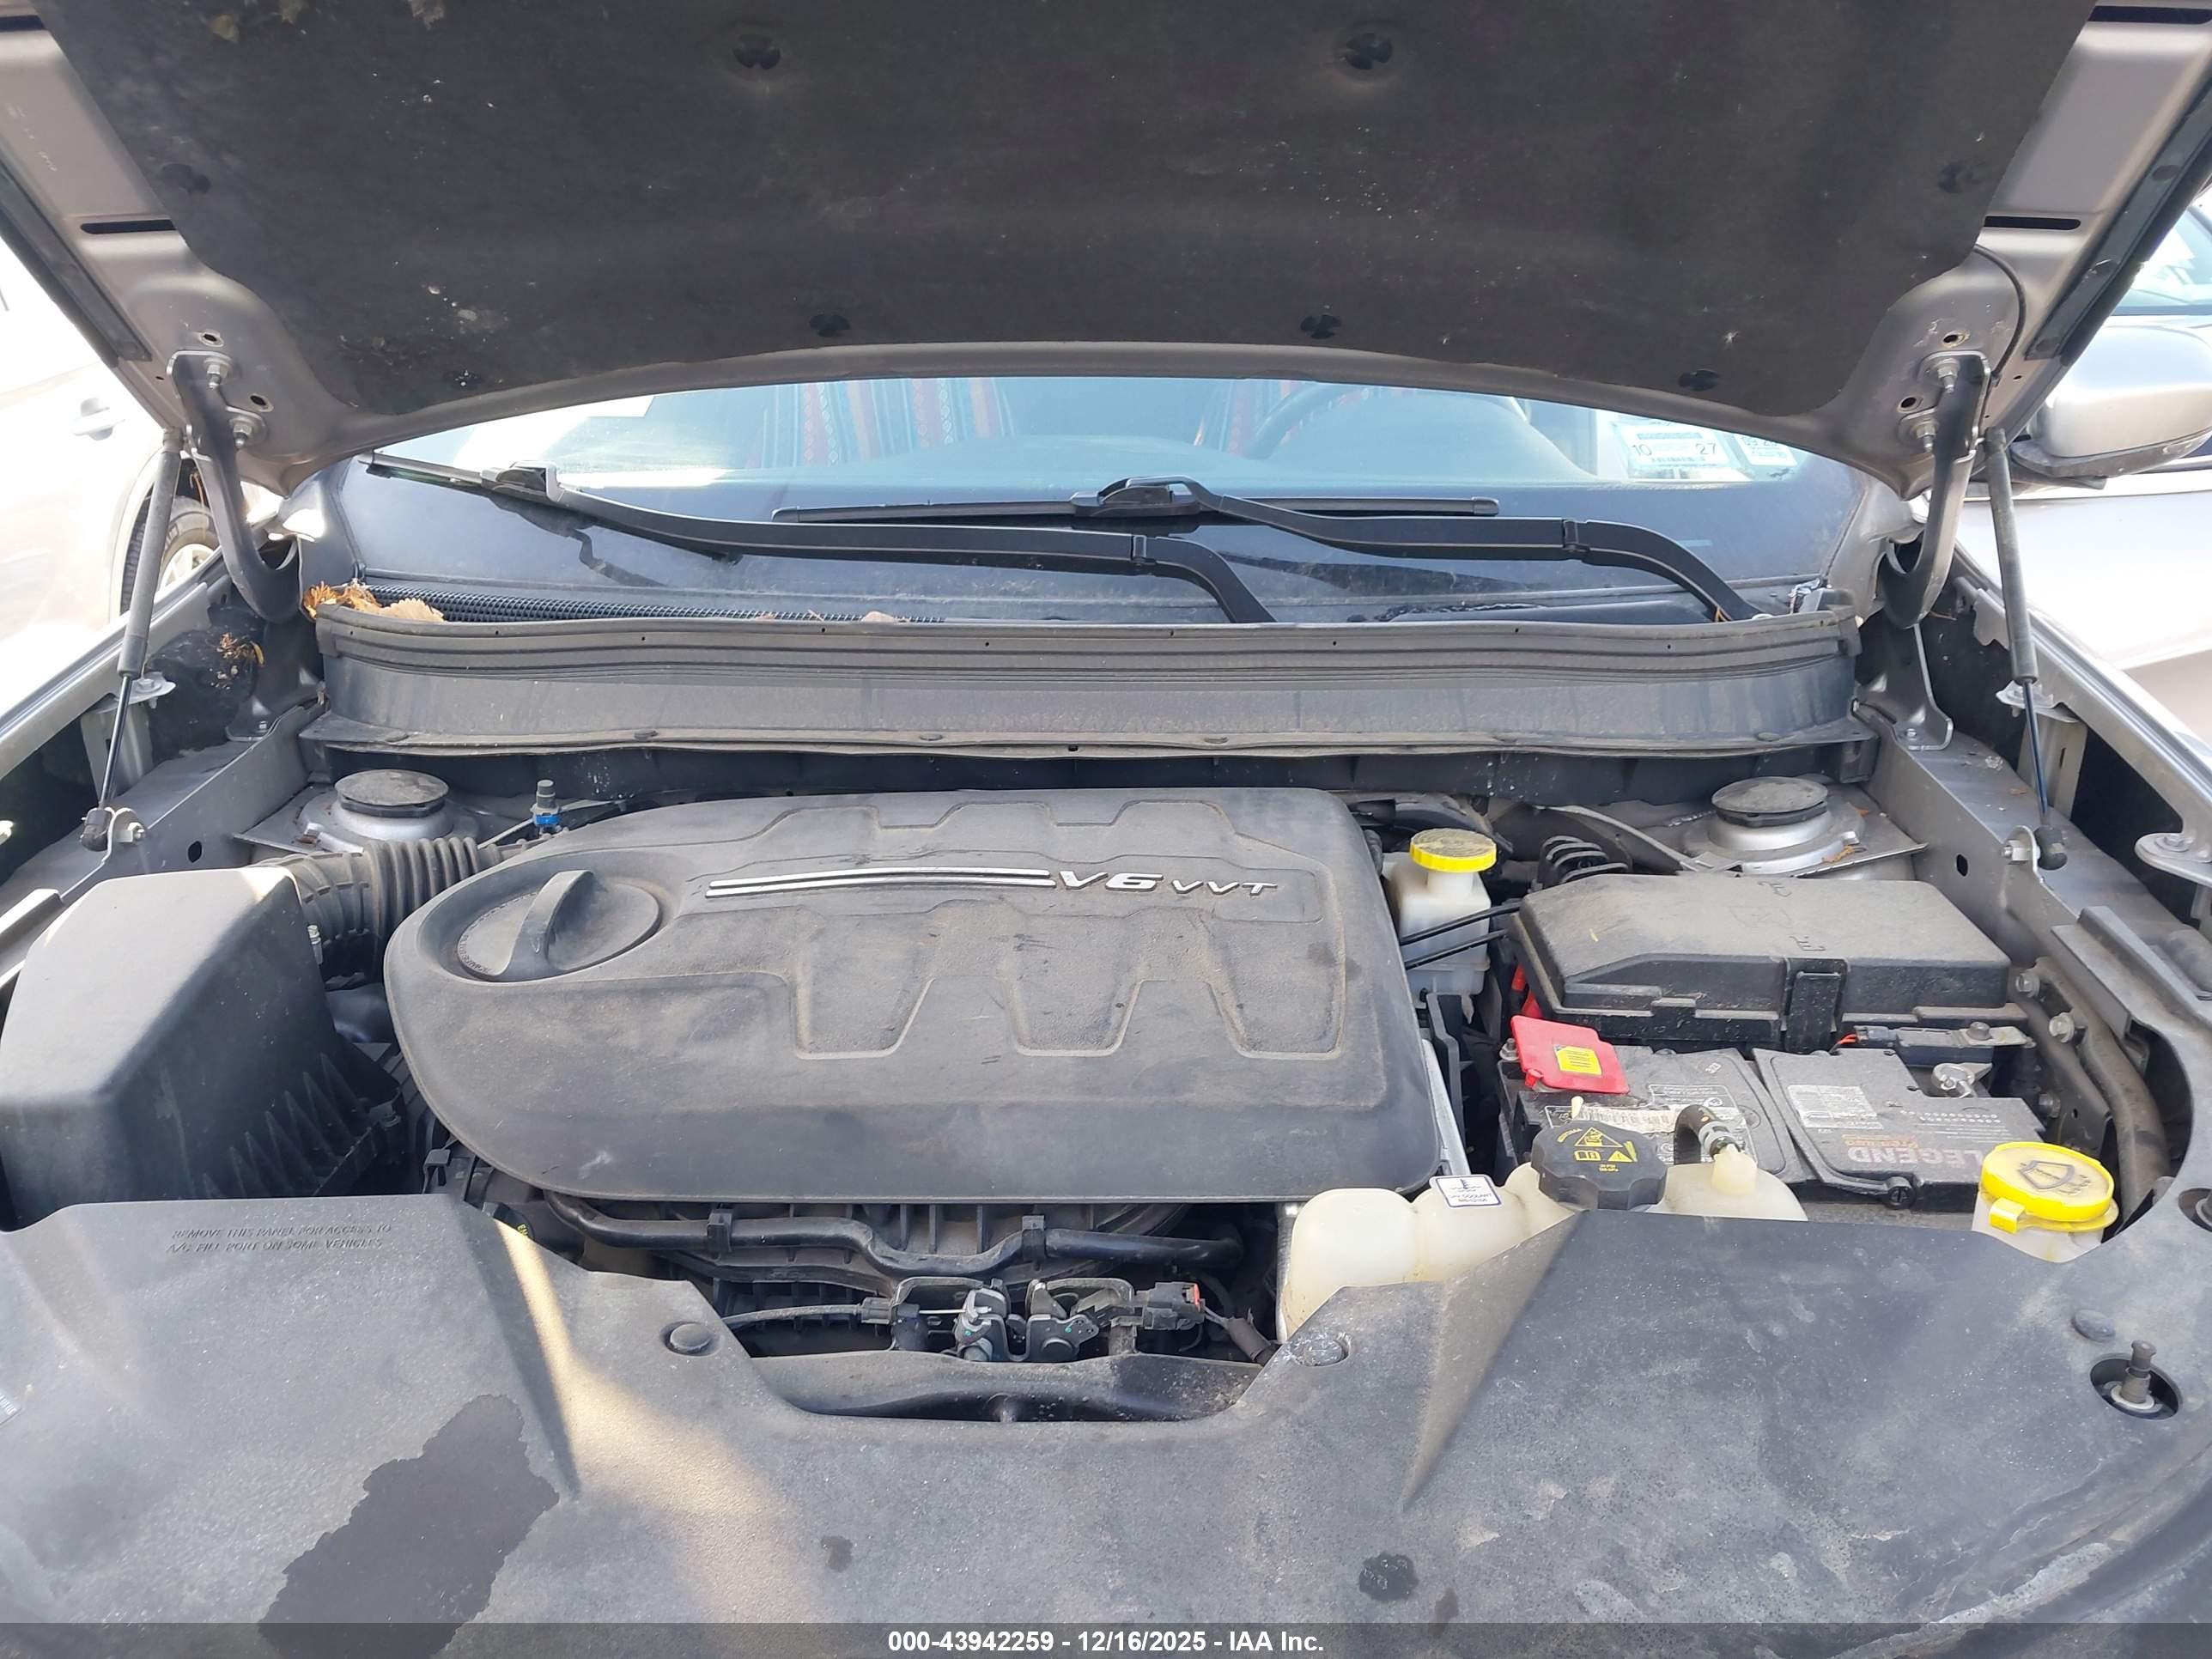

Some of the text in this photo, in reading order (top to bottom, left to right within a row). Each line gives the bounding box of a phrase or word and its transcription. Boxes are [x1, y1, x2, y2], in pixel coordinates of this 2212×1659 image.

[1632, 442, 1717, 457] 10 27
[1059, 869, 1278, 896] V6 VVT
[1846, 1146, 1984, 1165] LEGEND
[172, 1223, 392, 1238] REMOVE THIS PANEL FOR ACCESS TO
[166, 1243, 191, 1253] A/C
[226, 1242, 259, 1252] PORT
[263, 1241, 283, 1251] ON
[286, 1240, 318, 1250] SOME
[325, 1238, 383, 1250] VEHICLES
